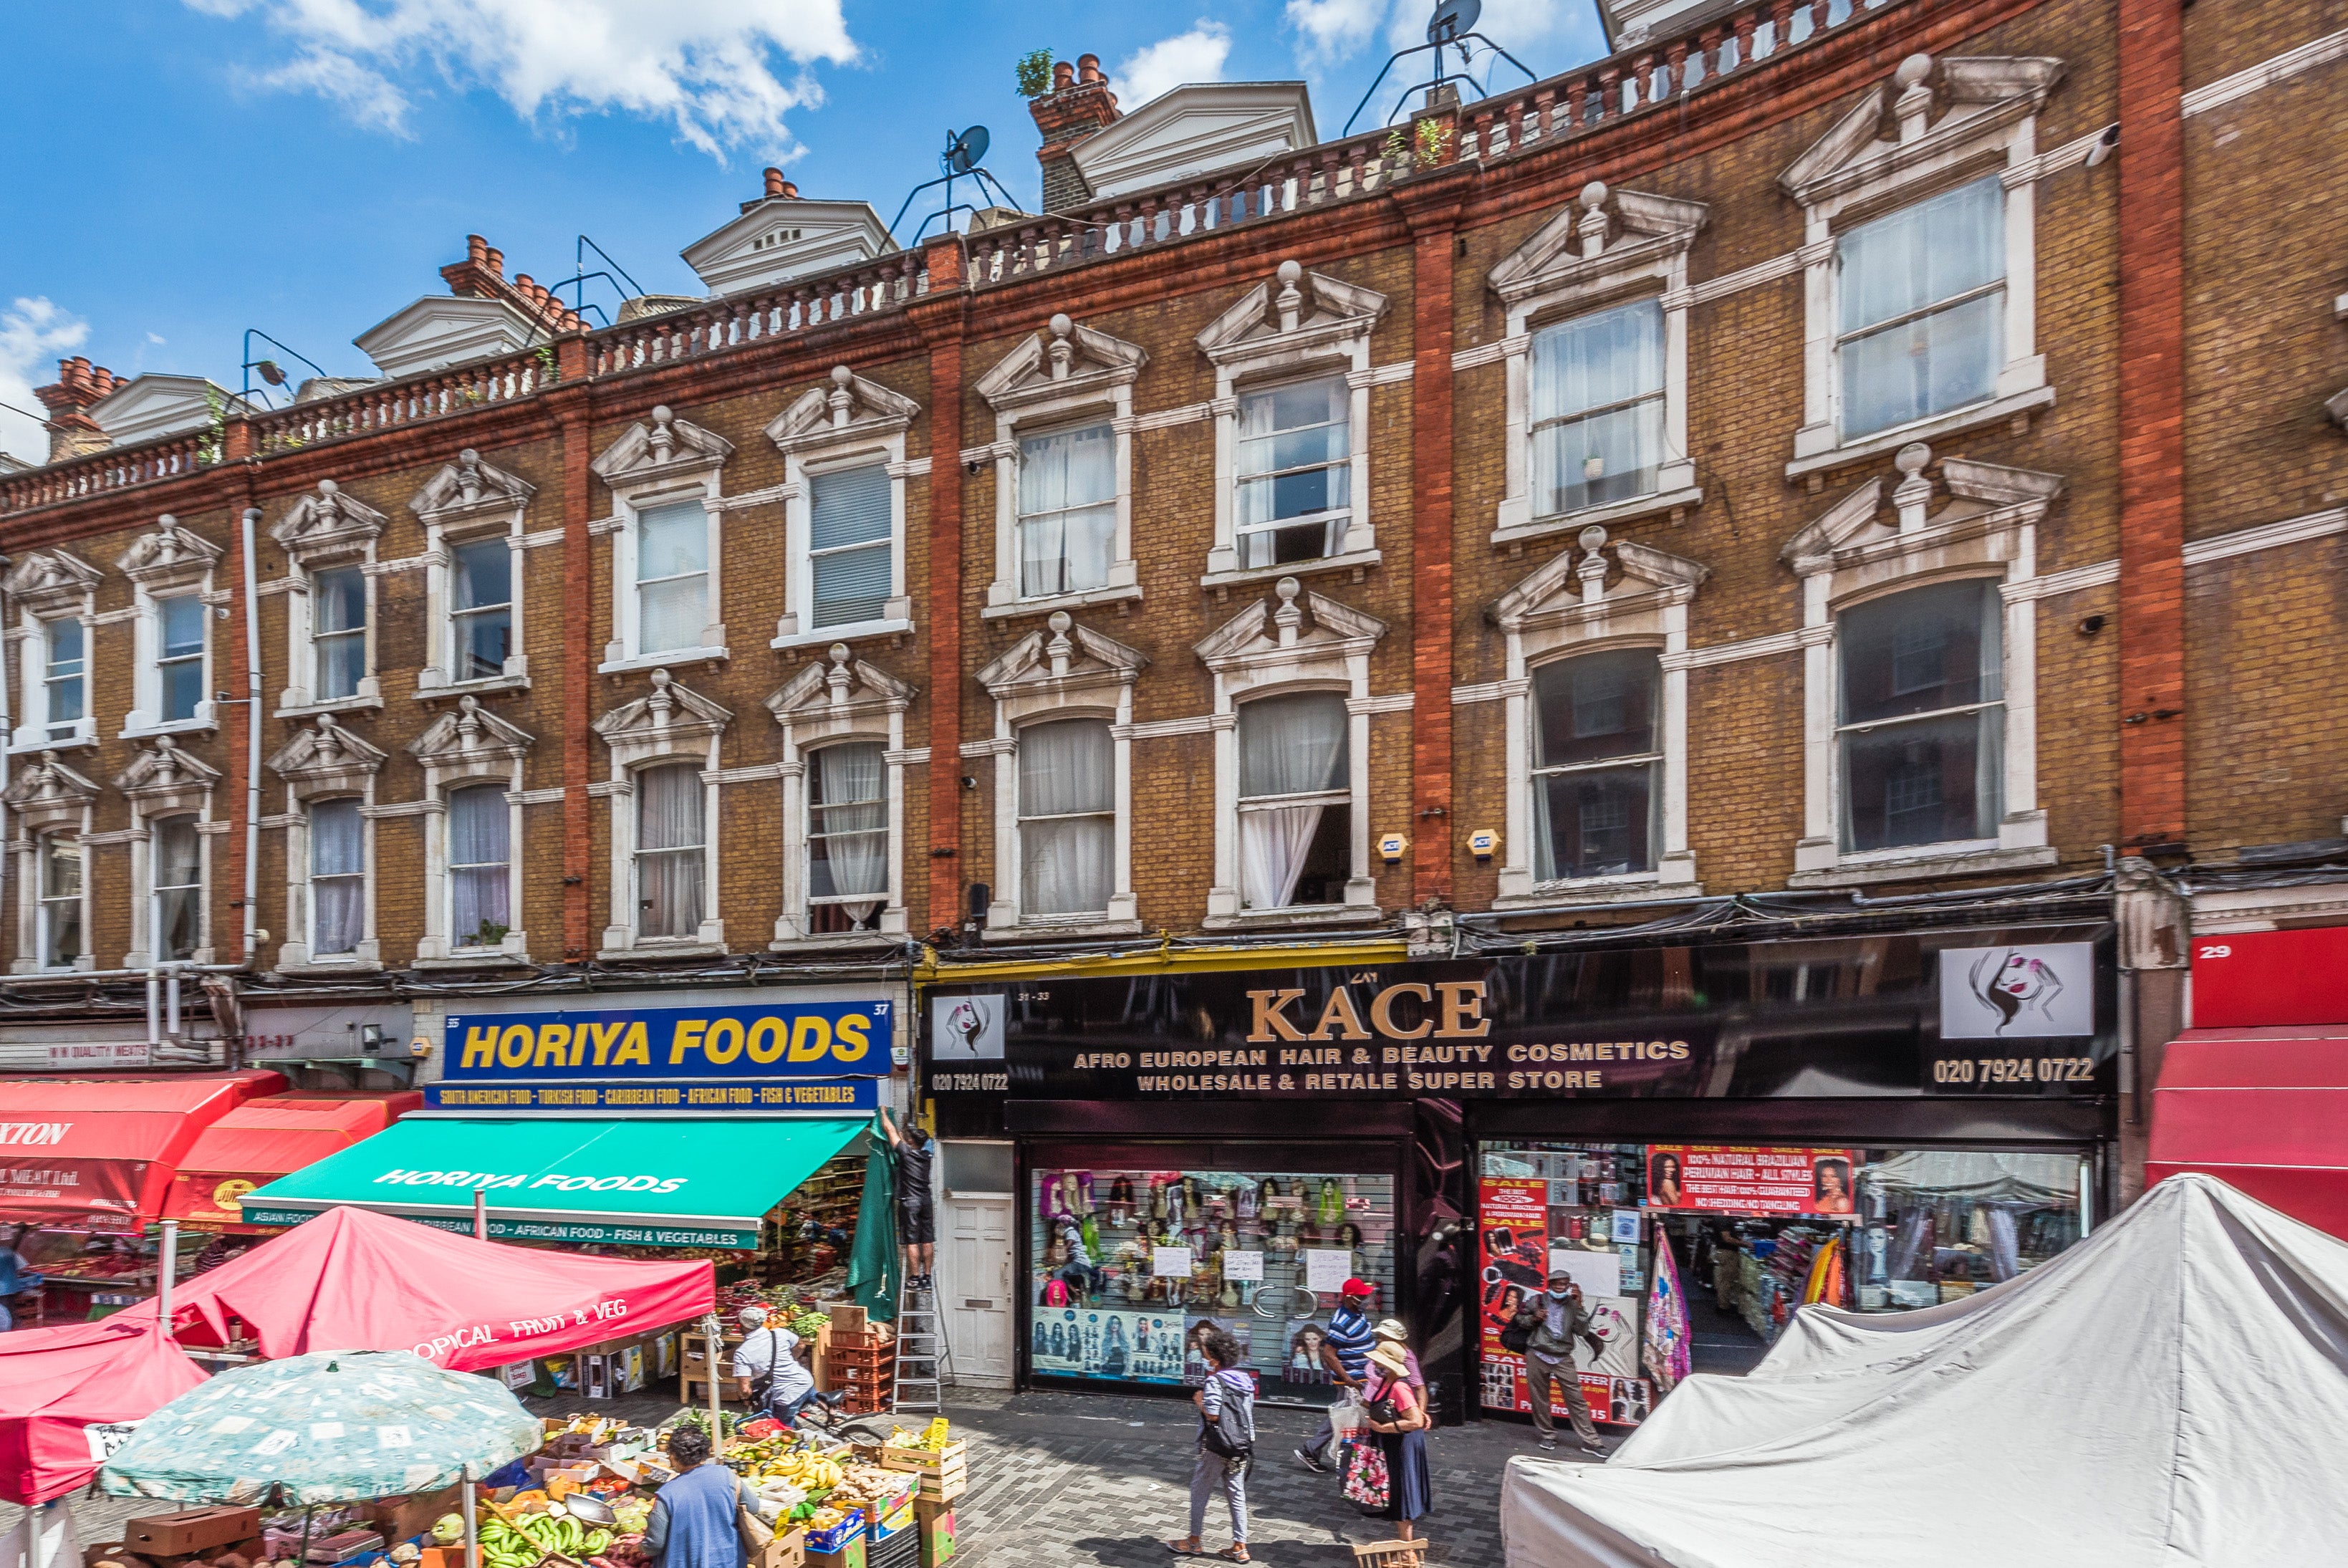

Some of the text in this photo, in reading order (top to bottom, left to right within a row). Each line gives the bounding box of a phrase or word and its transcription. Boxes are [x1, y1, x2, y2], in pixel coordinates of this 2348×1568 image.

[2199, 946, 2231, 958] 29
[1037, 992, 1049, 1001] 33
[873, 1004, 889, 1015] 37
[1246, 981, 1491, 1042] KACE
[461, 1014, 871, 1068] HORIYA FOODS
[1074, 1041, 1690, 1069] AFRO EUROPEAN HAIR & BEAUTY COSMETICS
[1934, 1057, 2094, 1083] 020 7924 0722
[932, 1074, 1009, 1090] 020 7924 0722
[1137, 1071, 1602, 1091] WHOLESALE & RETALE SUPER STORE
[440, 1090, 465, 1104] SOUTH
[467, 1090, 509, 1104] AMERICAN
[510, 1090, 531, 1104] FOOD
[538, 1090, 573, 1104] TURKISH
[575, 1090, 597, 1104] FOOD
[605, 1089, 655, 1104] CARIBBEAN
[656, 1089, 680, 1104] FOOD
[688, 1088, 727, 1104] AFRICAN
[728, 1088, 753, 1104] FOOD
[761, 1087, 783, 1103] FISH
[794, 1087, 855, 1103] VEGETABLES
[1688, 1154, 1711, 1165] 100%
[1711, 1154, 1754, 1165] NATURAL
[372, 1169, 689, 1193] HORIYA FOODS
[1730, 1168, 1754, 1180] HAIR
[1761, 1169, 1780, 1180] ALL
[1781, 1170, 1813, 1181] STYLES
[1482, 1180, 1545, 1188] SALE
[253, 1212, 285, 1222] ASIAN
[1483, 1218, 1545, 1227] SALE
[514, 1224, 567, 1238] AFRICAN
[569, 1228, 604, 1239] FOOD
[614, 1229, 642, 1241] FISH
[644, 1231, 653, 1241] &
[656, 1231, 737, 1245] VEGETABLES
[401, 1299, 627, 1360] OPICAL FRUIT & VEG
[1484, 1354, 1526, 1365] SAL
[1578, 1375, 1608, 1385] FFER
[1551, 1404, 1569, 1415] fro
